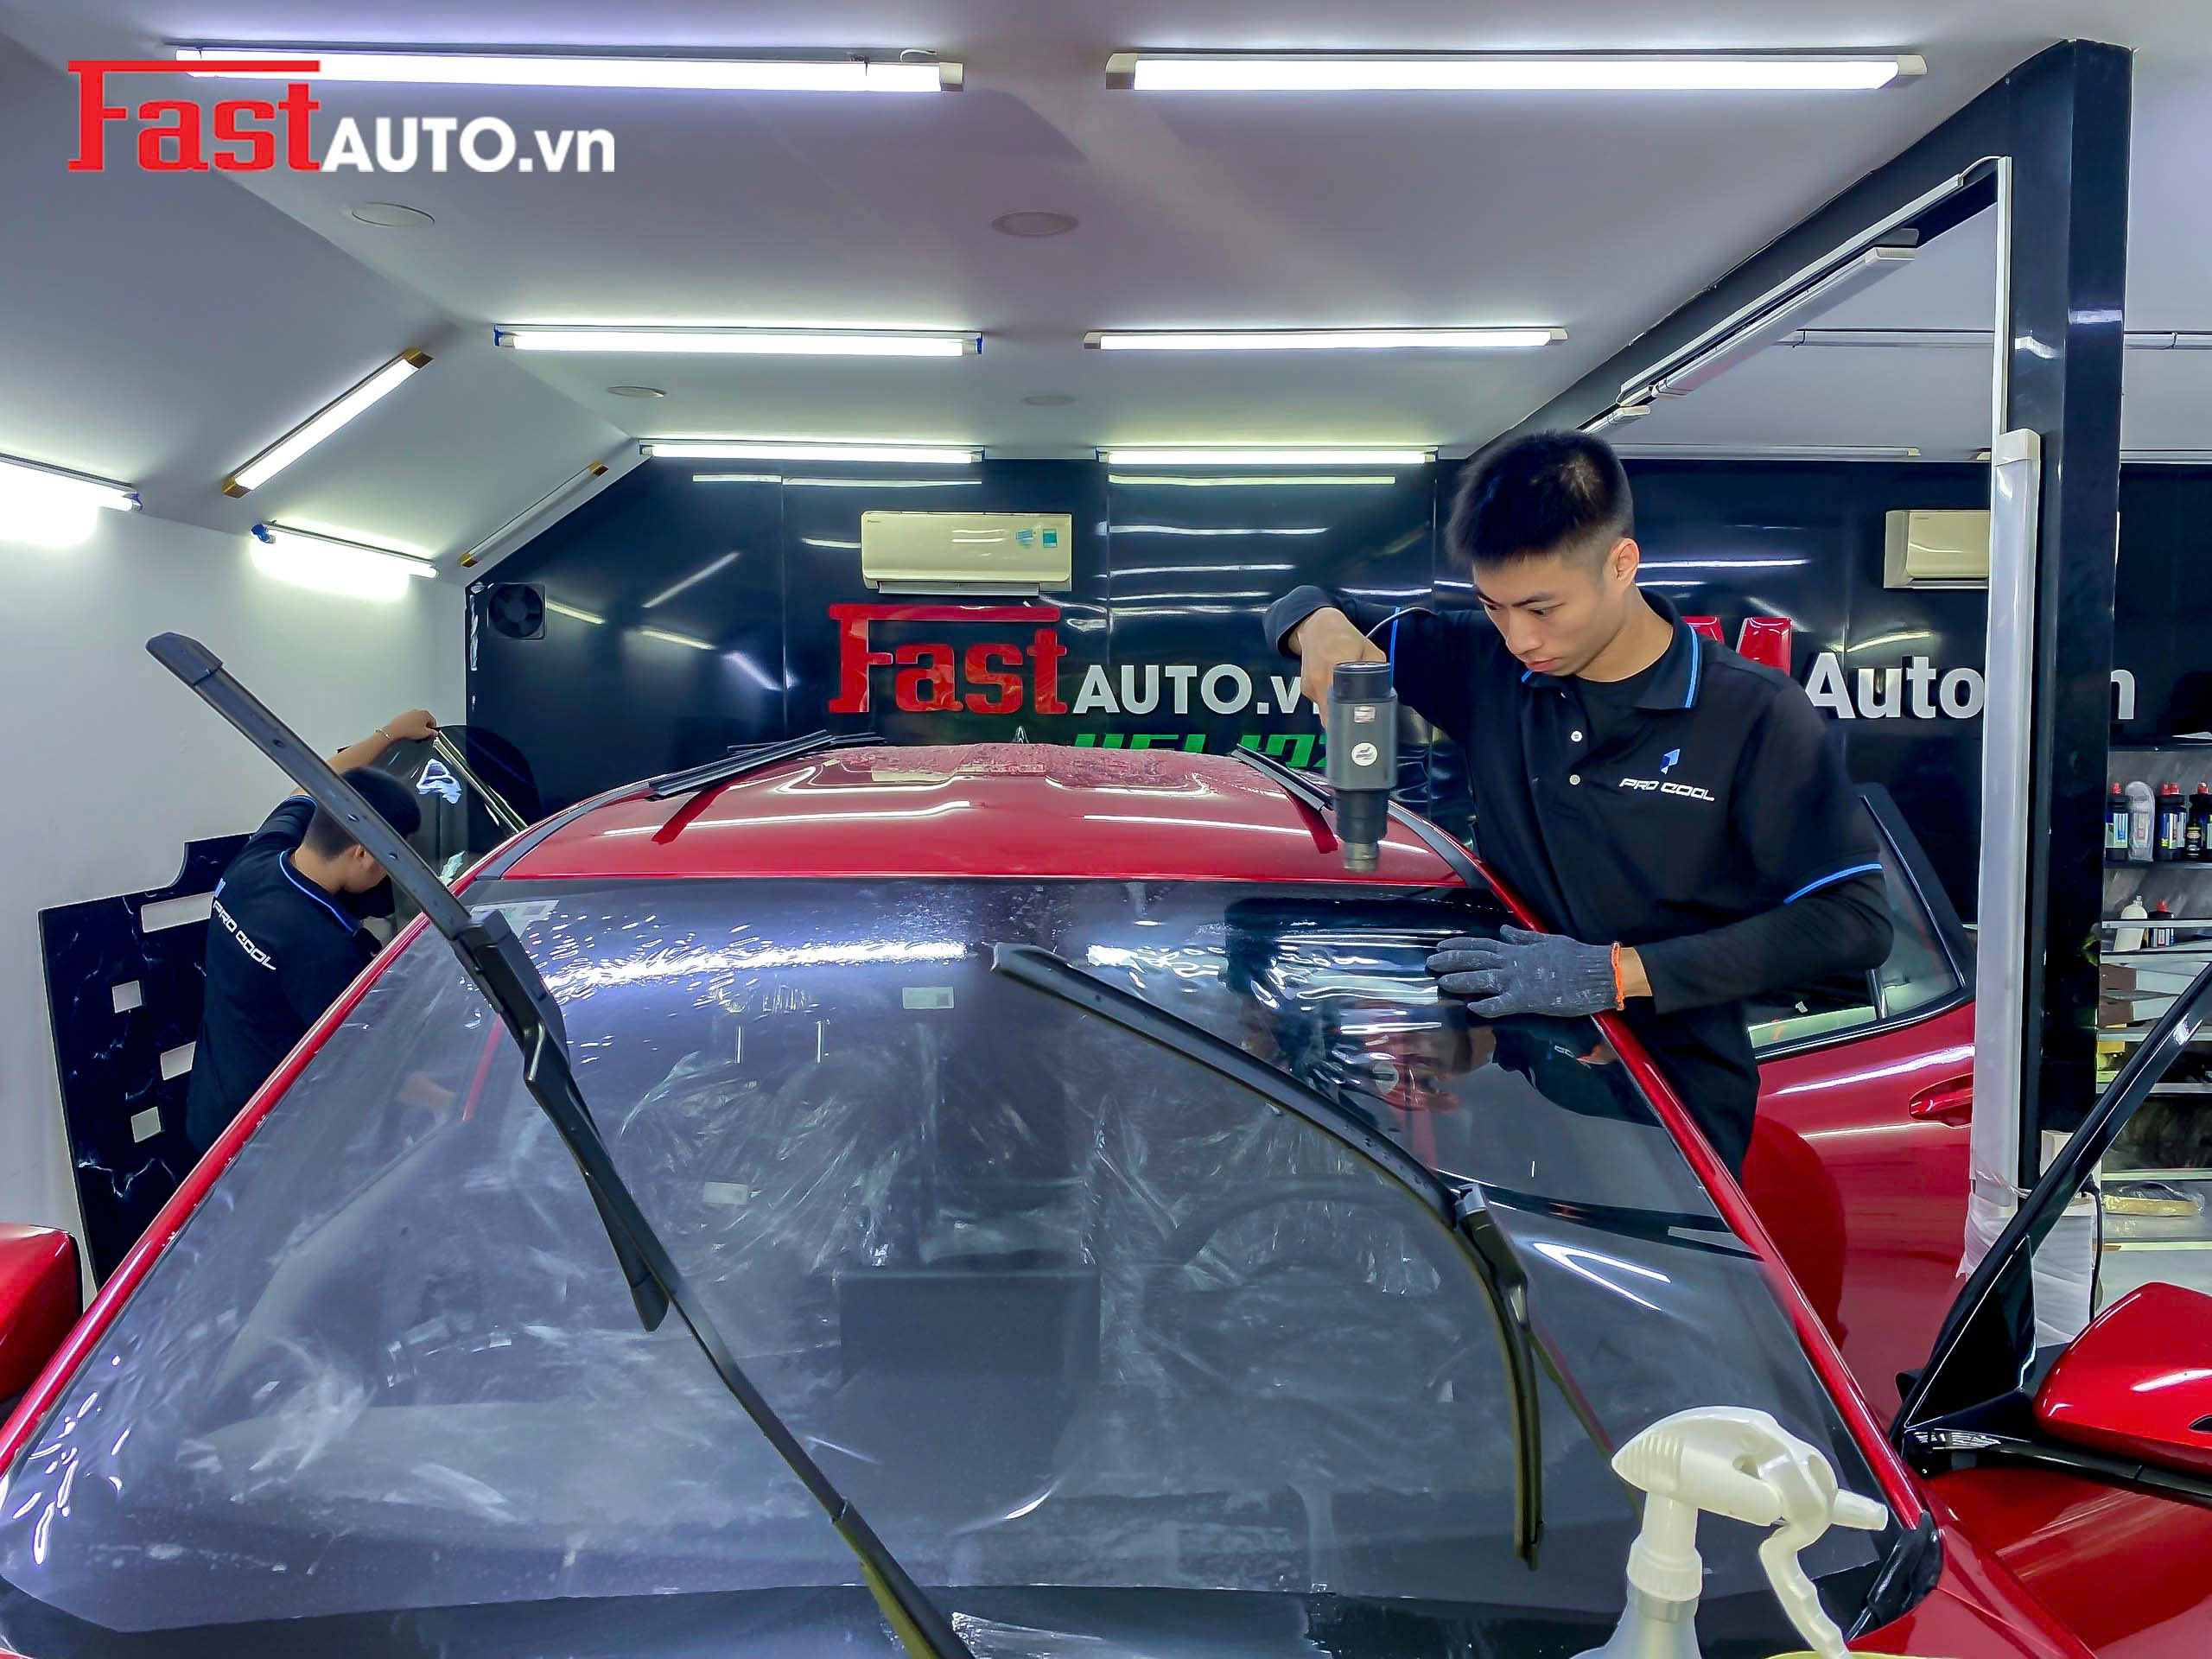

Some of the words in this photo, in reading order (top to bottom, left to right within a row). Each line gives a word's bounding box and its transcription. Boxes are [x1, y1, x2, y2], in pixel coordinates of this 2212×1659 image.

[1072, 664, 1320, 715] AUTO.v
[1618, 778, 1660, 791] PRO
[1660, 782, 1715, 802] COOL
[213, 899, 238, 933] PRO
[235, 930, 276, 970] COOL
